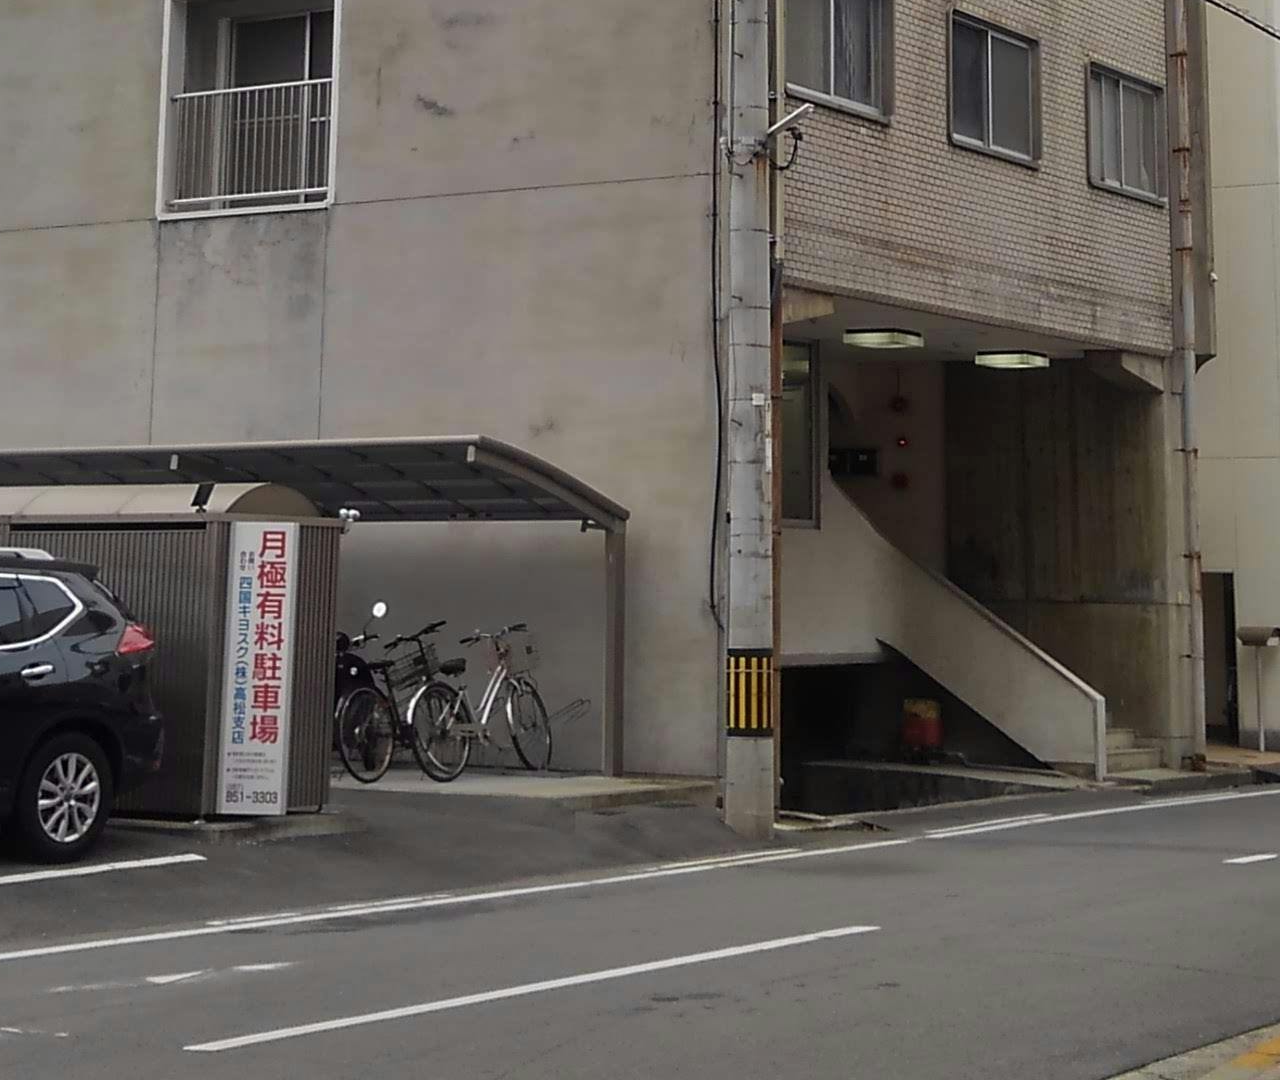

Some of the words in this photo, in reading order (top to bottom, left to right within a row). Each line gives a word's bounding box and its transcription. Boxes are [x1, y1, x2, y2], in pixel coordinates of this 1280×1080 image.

[249, 530, 288, 746] 月極有料駐車場
